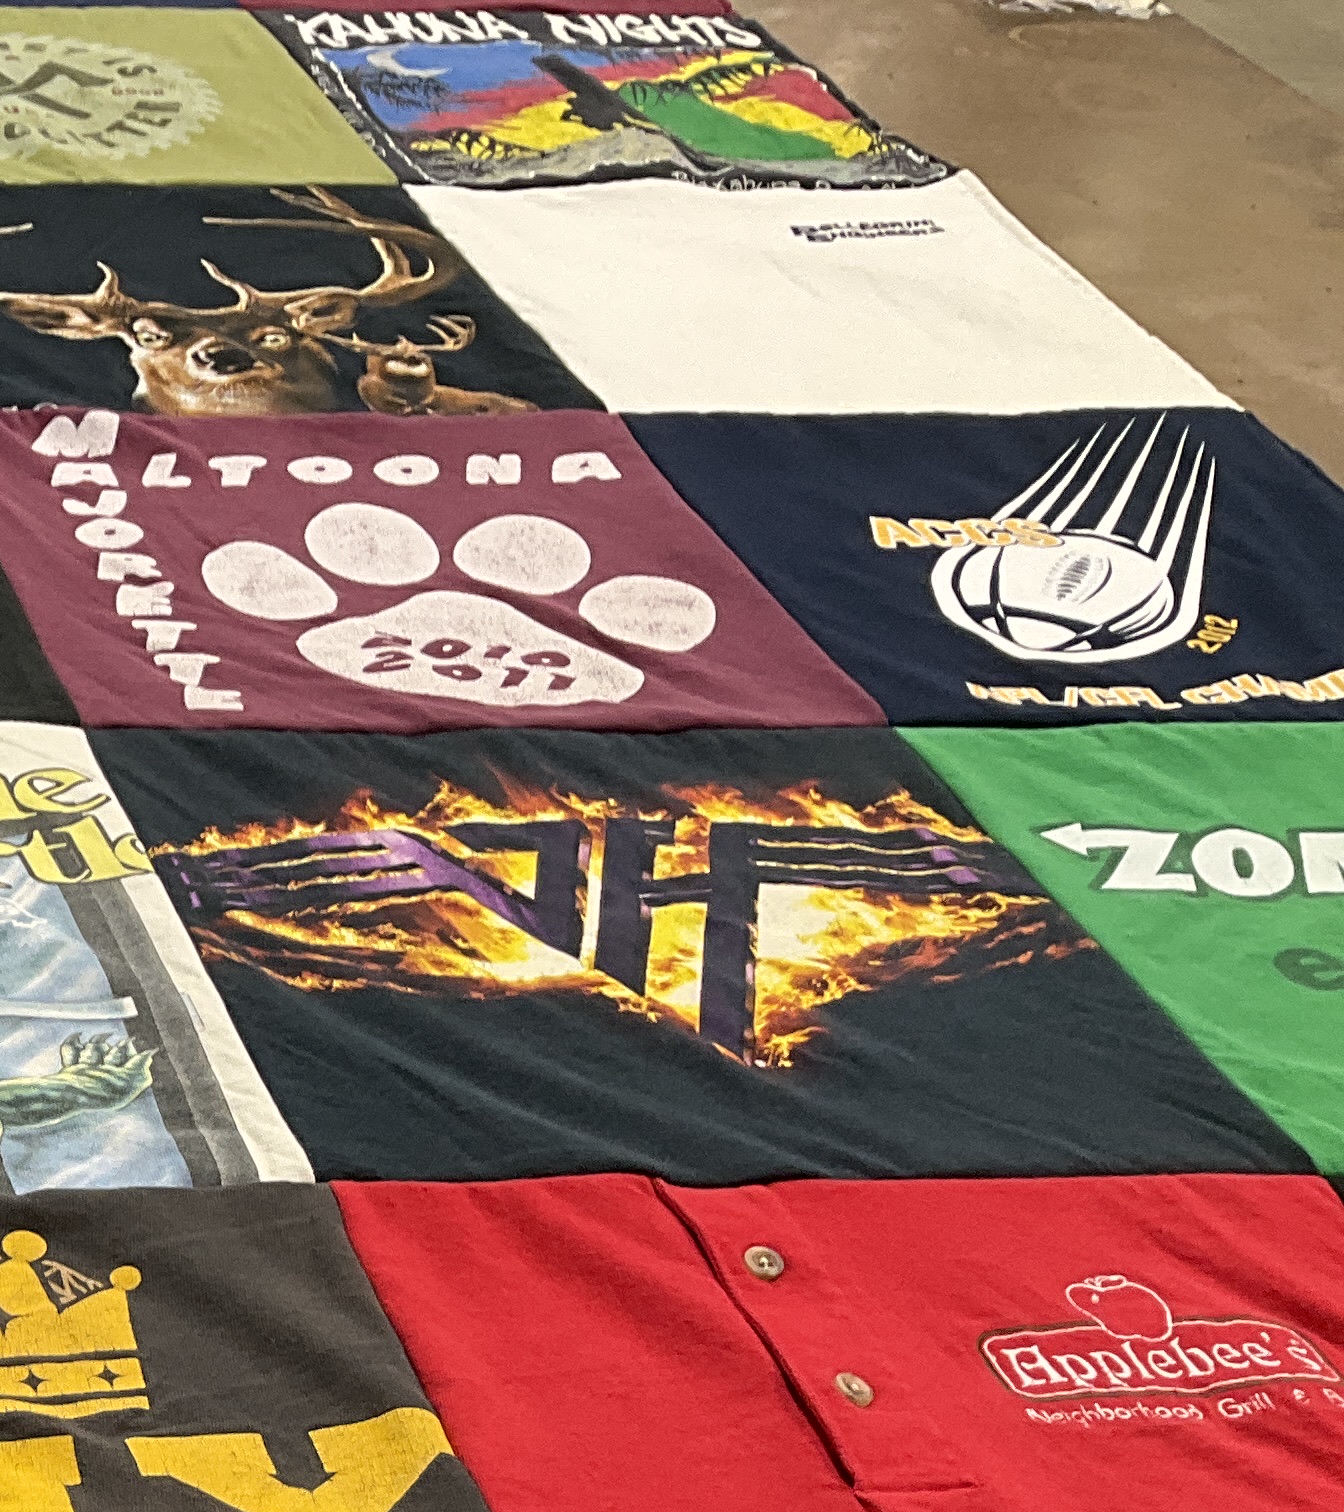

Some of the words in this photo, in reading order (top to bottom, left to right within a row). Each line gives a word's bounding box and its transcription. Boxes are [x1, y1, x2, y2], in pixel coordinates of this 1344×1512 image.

[299, 11, 529, 49] KAHUNA
[542, 12, 762, 49] NIGHTS
[868, 514, 1065, 550] ACCS
[1186, 613, 1239, 655] 2012
[999, 1331, 1323, 1390] Applebee's
[1025, 1401, 1204, 1428] Neighborhood
[1217, 1391, 1276, 1419] Grill
